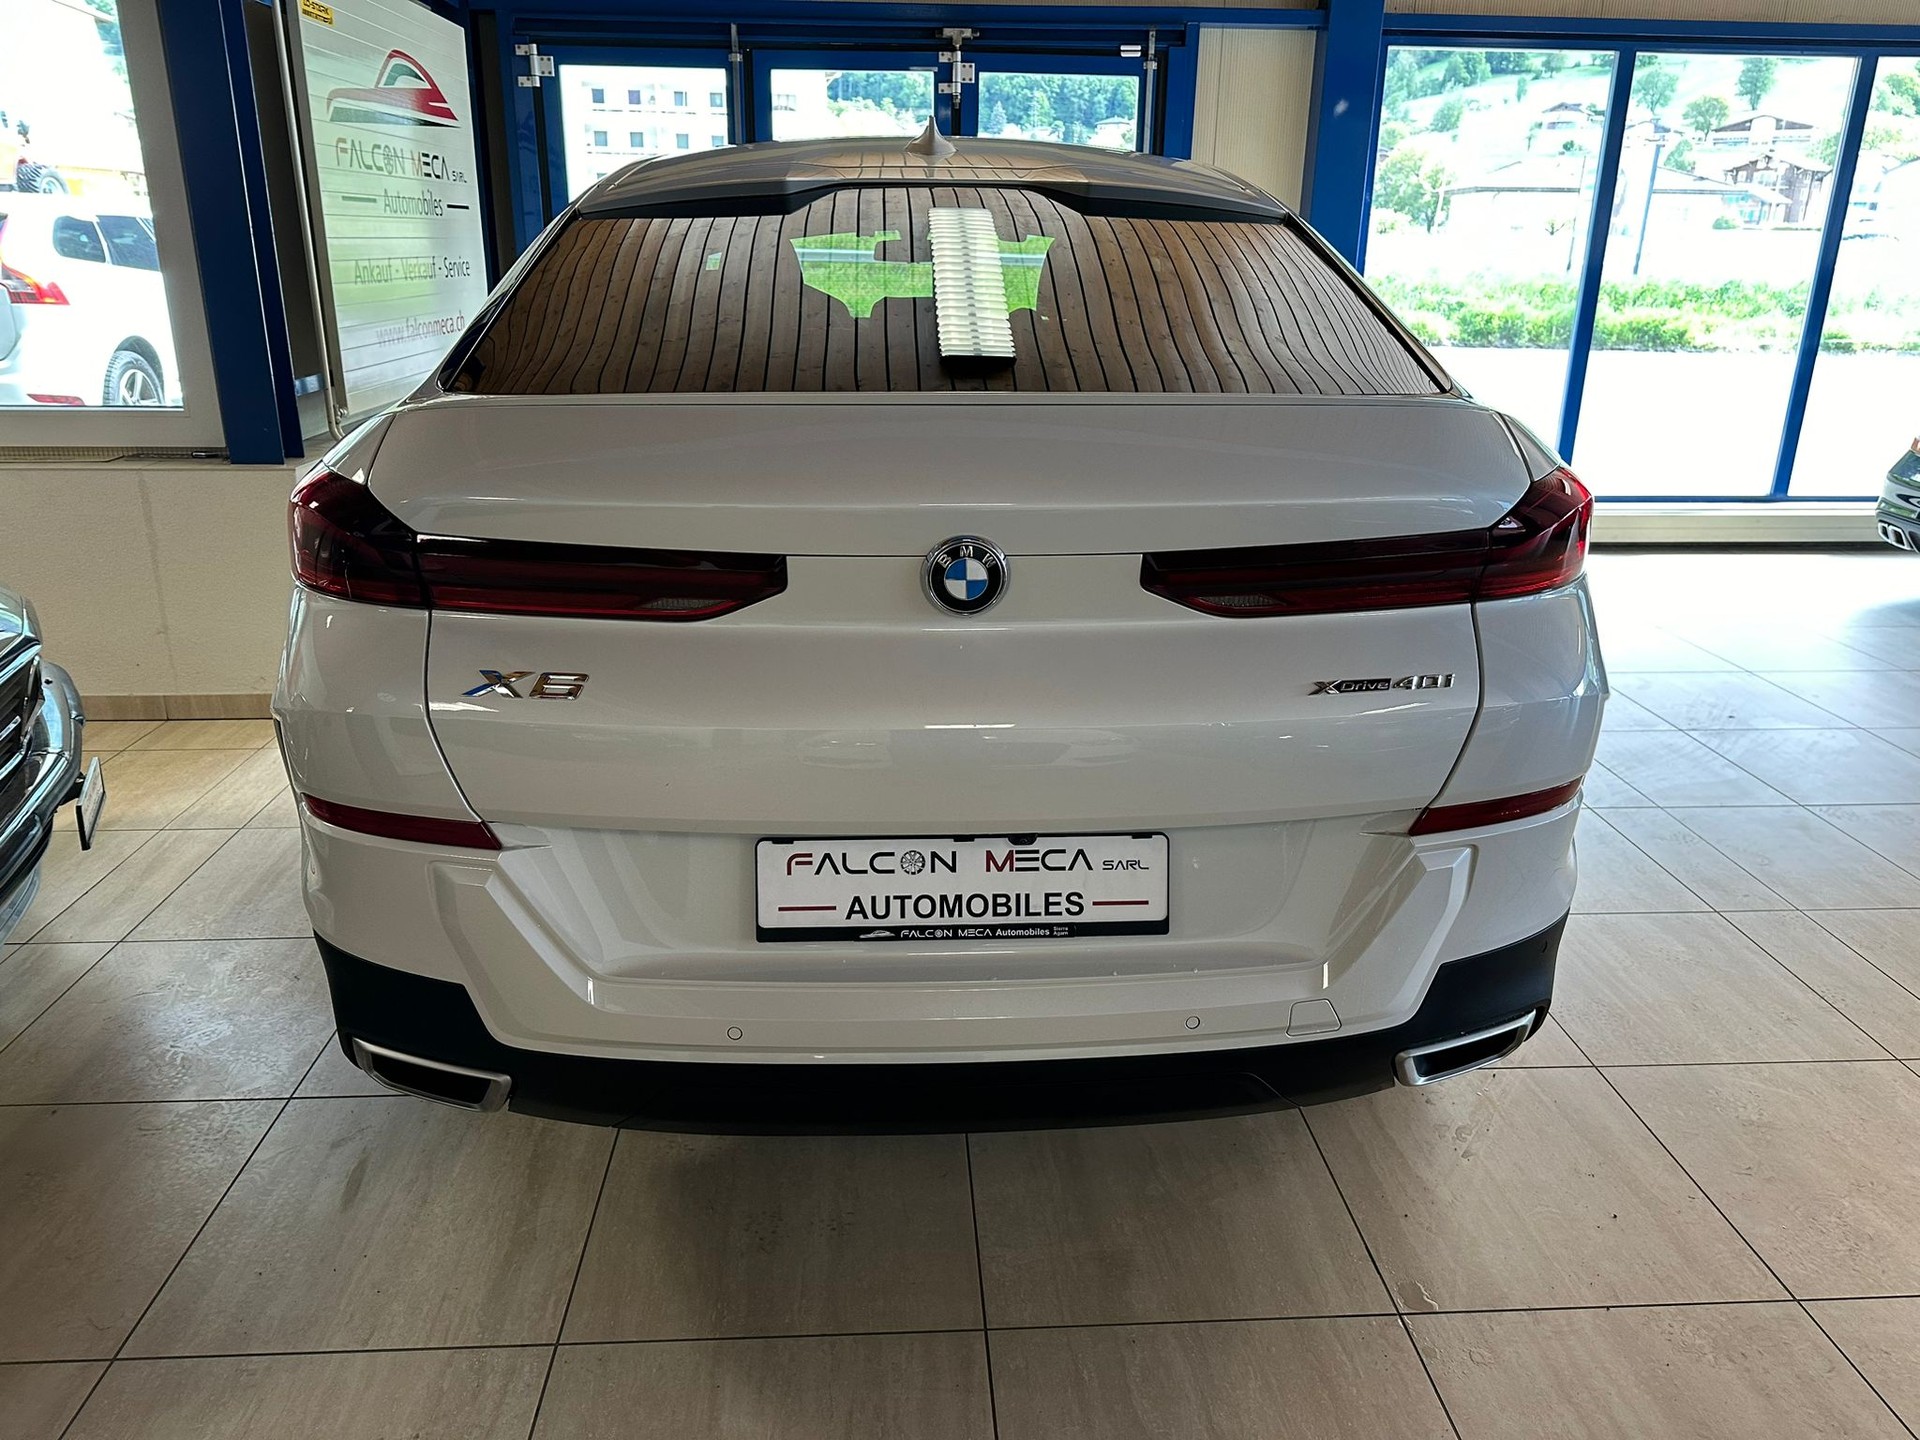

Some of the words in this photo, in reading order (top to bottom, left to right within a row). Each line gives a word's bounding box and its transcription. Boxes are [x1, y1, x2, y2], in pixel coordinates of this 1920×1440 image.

[335, 137, 406, 175] FALCON
[410, 150, 450, 180] MECA
[383, 188, 444, 216] Automobiles
[354, 257, 393, 285] Ankauf
[401, 256, 436, 281] Verkauf
[443, 256, 470, 278] Service
[376, 310, 465, 348] www.falconmeca.ch
[461, 669, 590, 700] X6
[787, 850, 957, 876] FALCON
[985, 848, 1094, 873] MECA
[1102, 859, 1149, 871] SARL
[845, 891, 1085, 920] AUTOMOBILES
[900, 929, 953, 938] FALCON
[958, 928, 993, 937] MECA
[995, 927, 1050, 937] Automobiles
